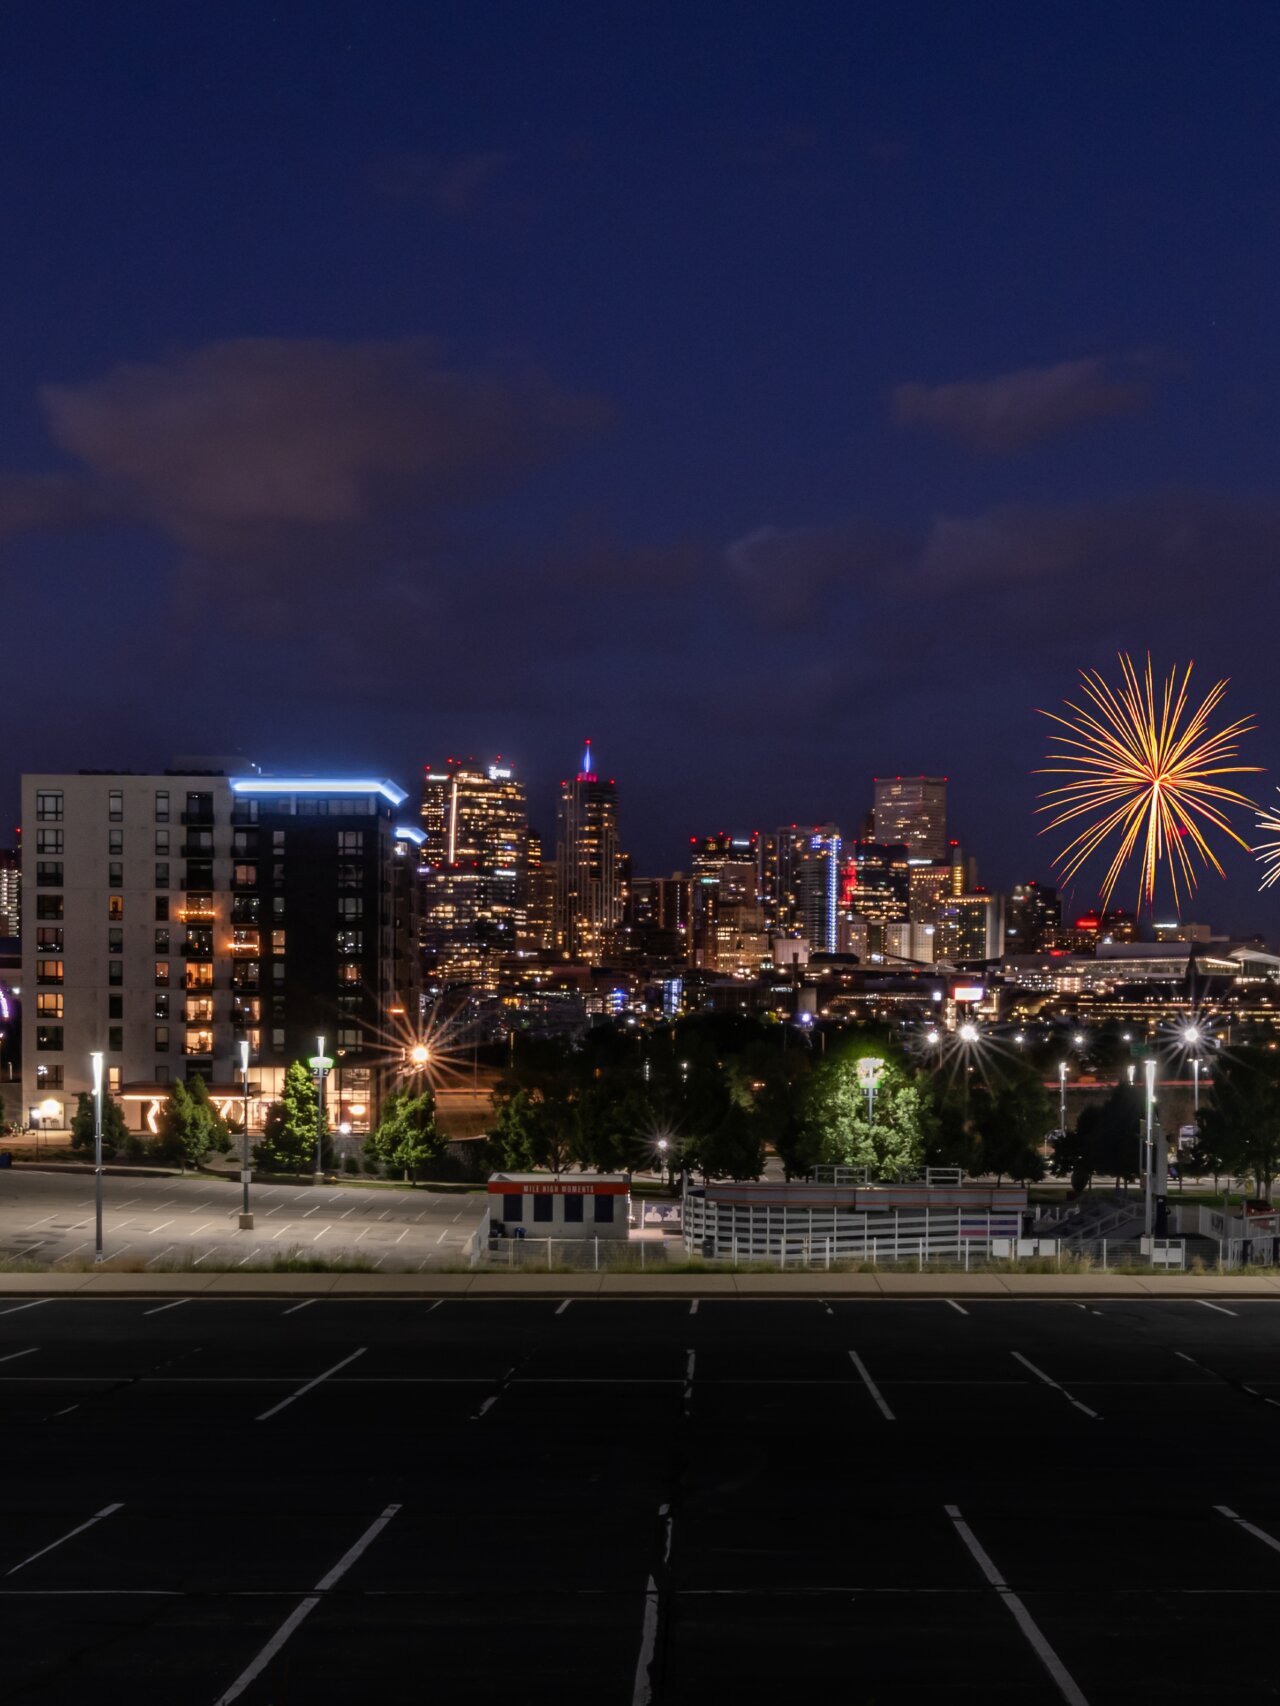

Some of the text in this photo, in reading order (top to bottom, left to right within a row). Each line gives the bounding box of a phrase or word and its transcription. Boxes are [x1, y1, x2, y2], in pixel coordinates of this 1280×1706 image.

[523, 1184, 595, 1194] MILE HIGH MOMENTS
